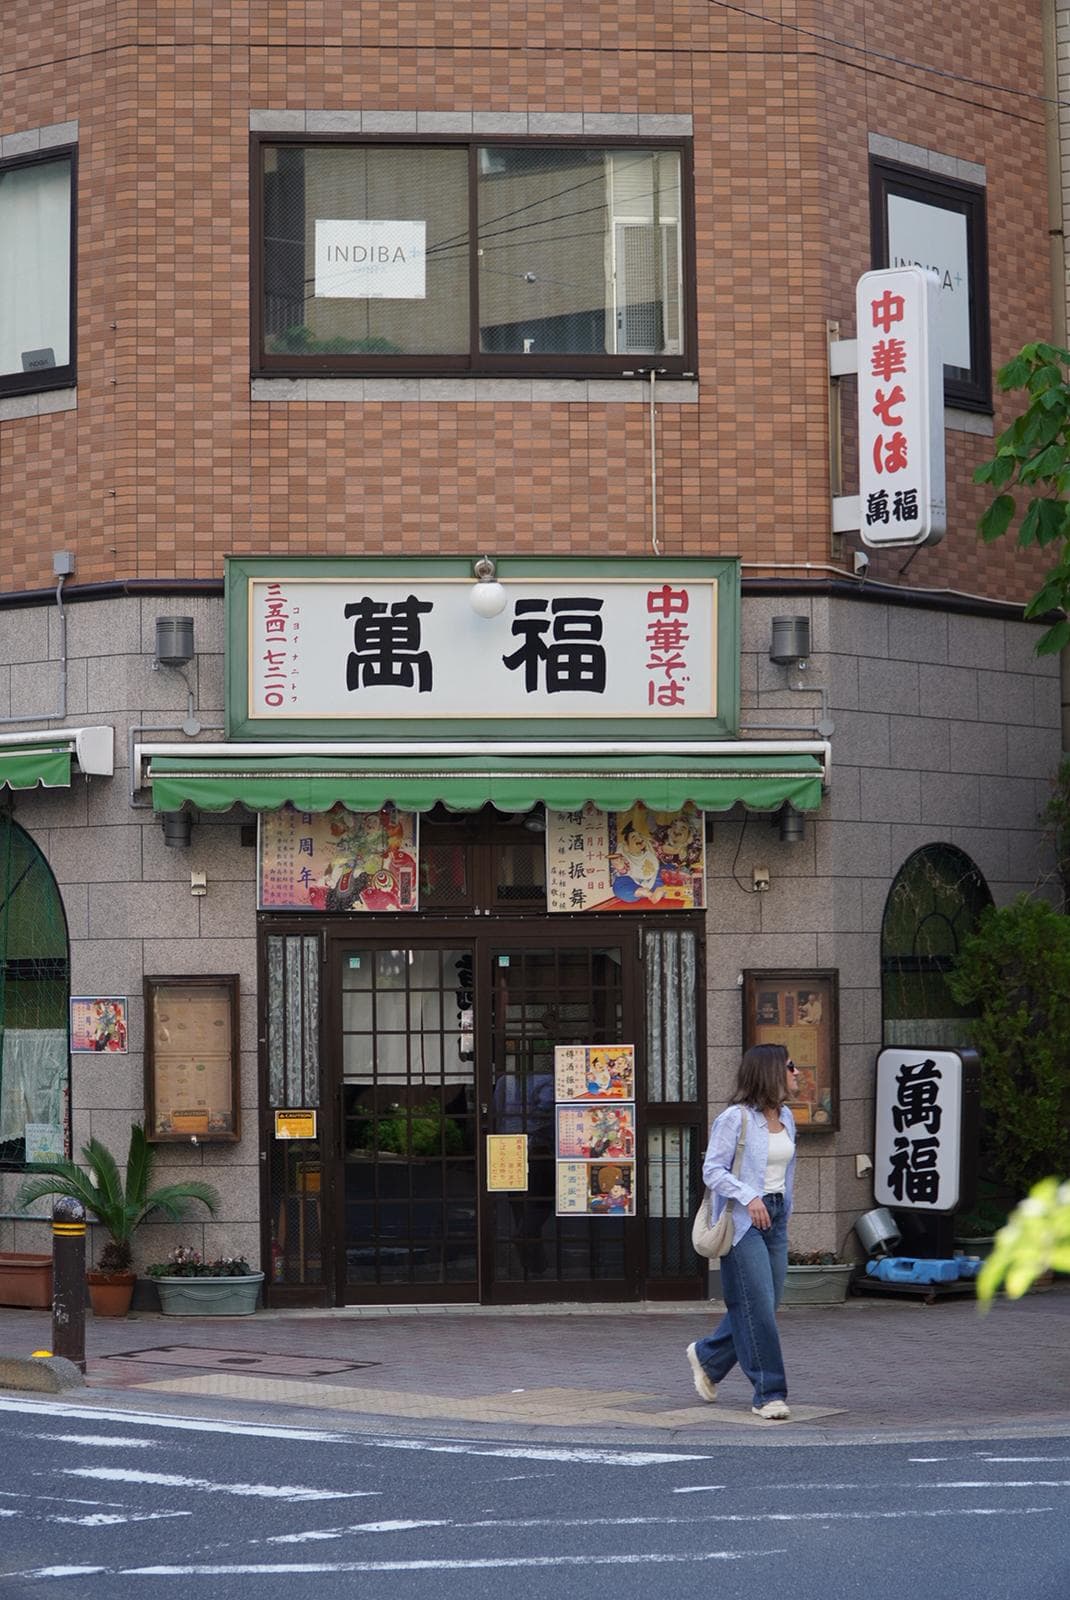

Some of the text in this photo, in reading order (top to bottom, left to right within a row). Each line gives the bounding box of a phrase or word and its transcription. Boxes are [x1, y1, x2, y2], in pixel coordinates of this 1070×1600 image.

[871, 290, 908, 475] 中華そば
[865, 488, 919, 527] 萬福
[645, 584, 691, 707] 中華そば
[887, 1059, 942, 1204] 萬福
